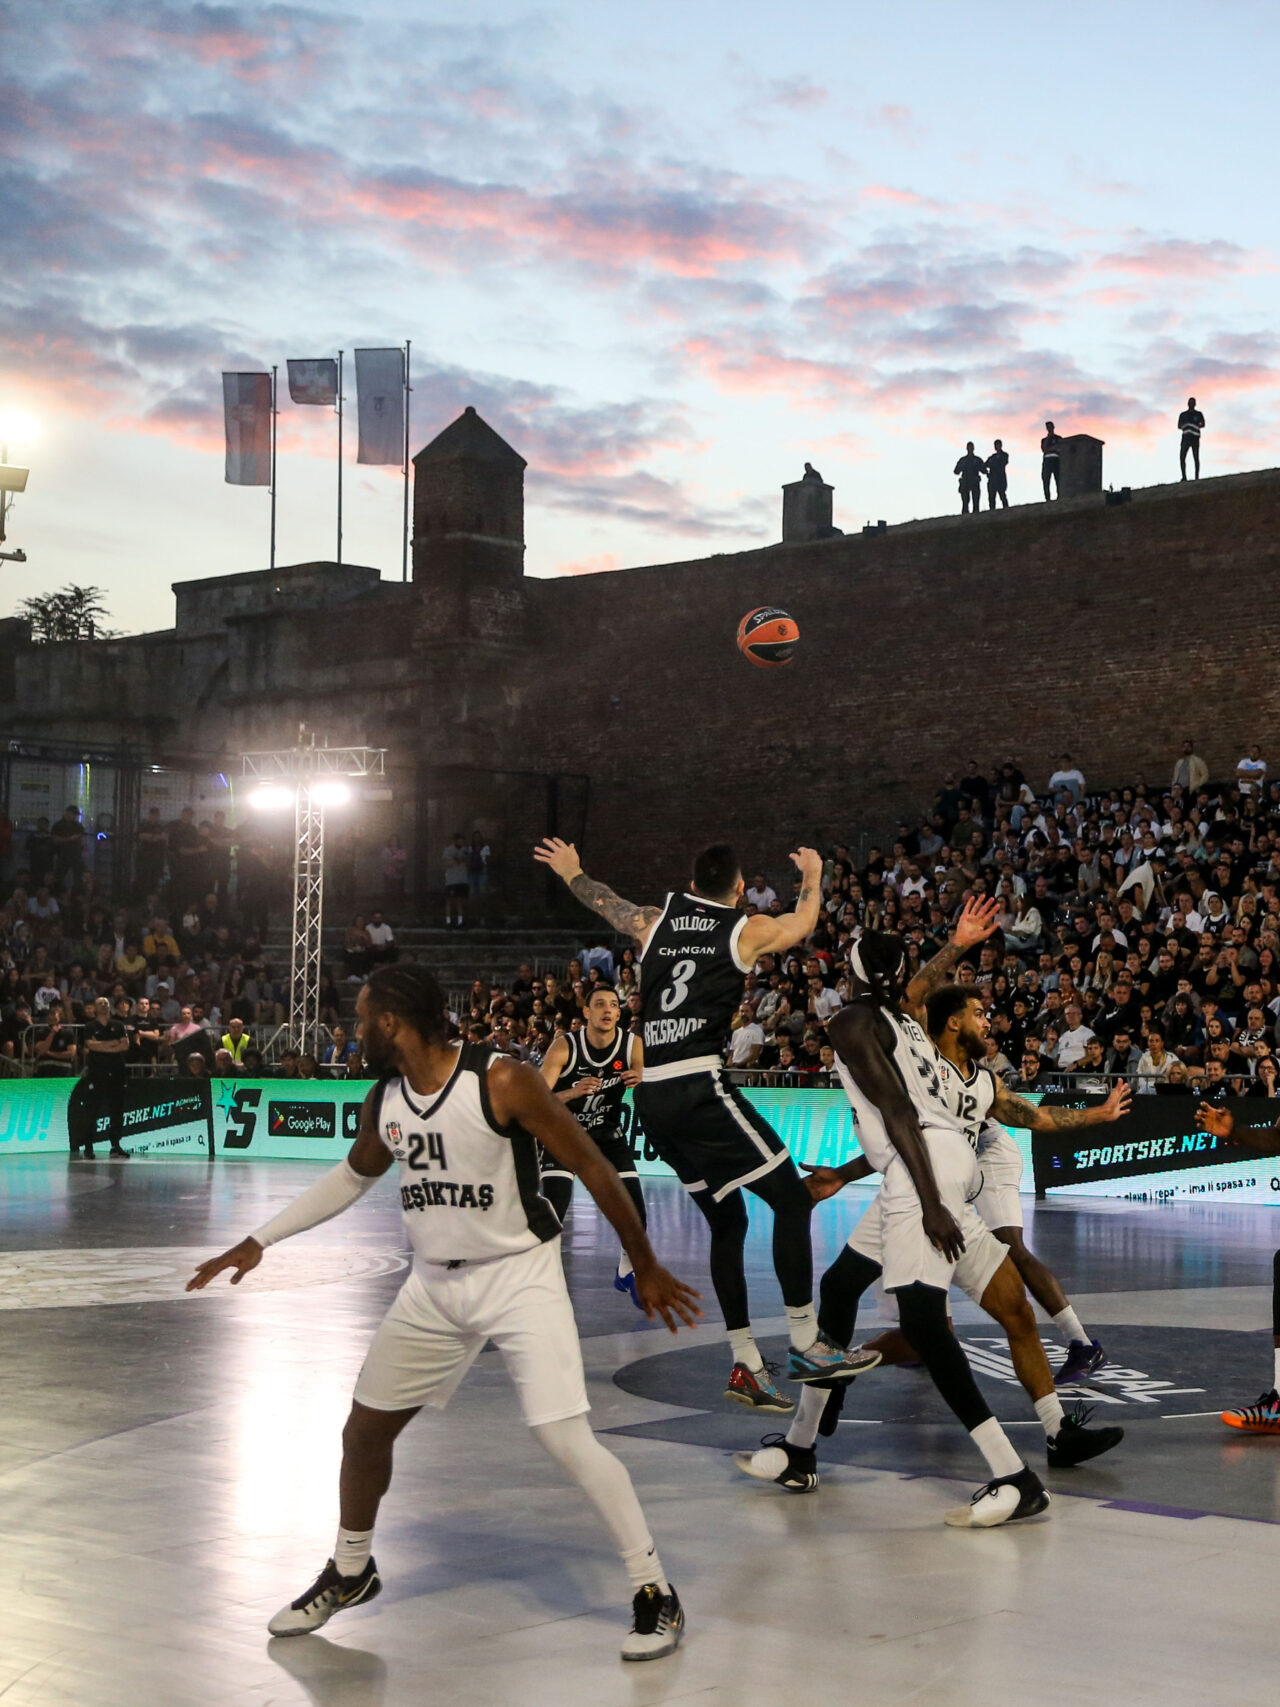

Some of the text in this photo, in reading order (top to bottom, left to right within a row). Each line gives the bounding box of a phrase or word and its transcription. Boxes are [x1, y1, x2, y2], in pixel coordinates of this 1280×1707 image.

[661, 960, 697, 1012] 3
[96, 1101, 175, 1133] SPTSKE.NET
[956, 1091, 977, 1121] 12
[287, 1116, 331, 1133] Google Play
[408, 1133, 447, 1170] 24
[1189, 1184, 1206, 1194] ima
[1216, 1182, 1243, 1193] spasa
[1246, 1177, 1256, 1187] za
